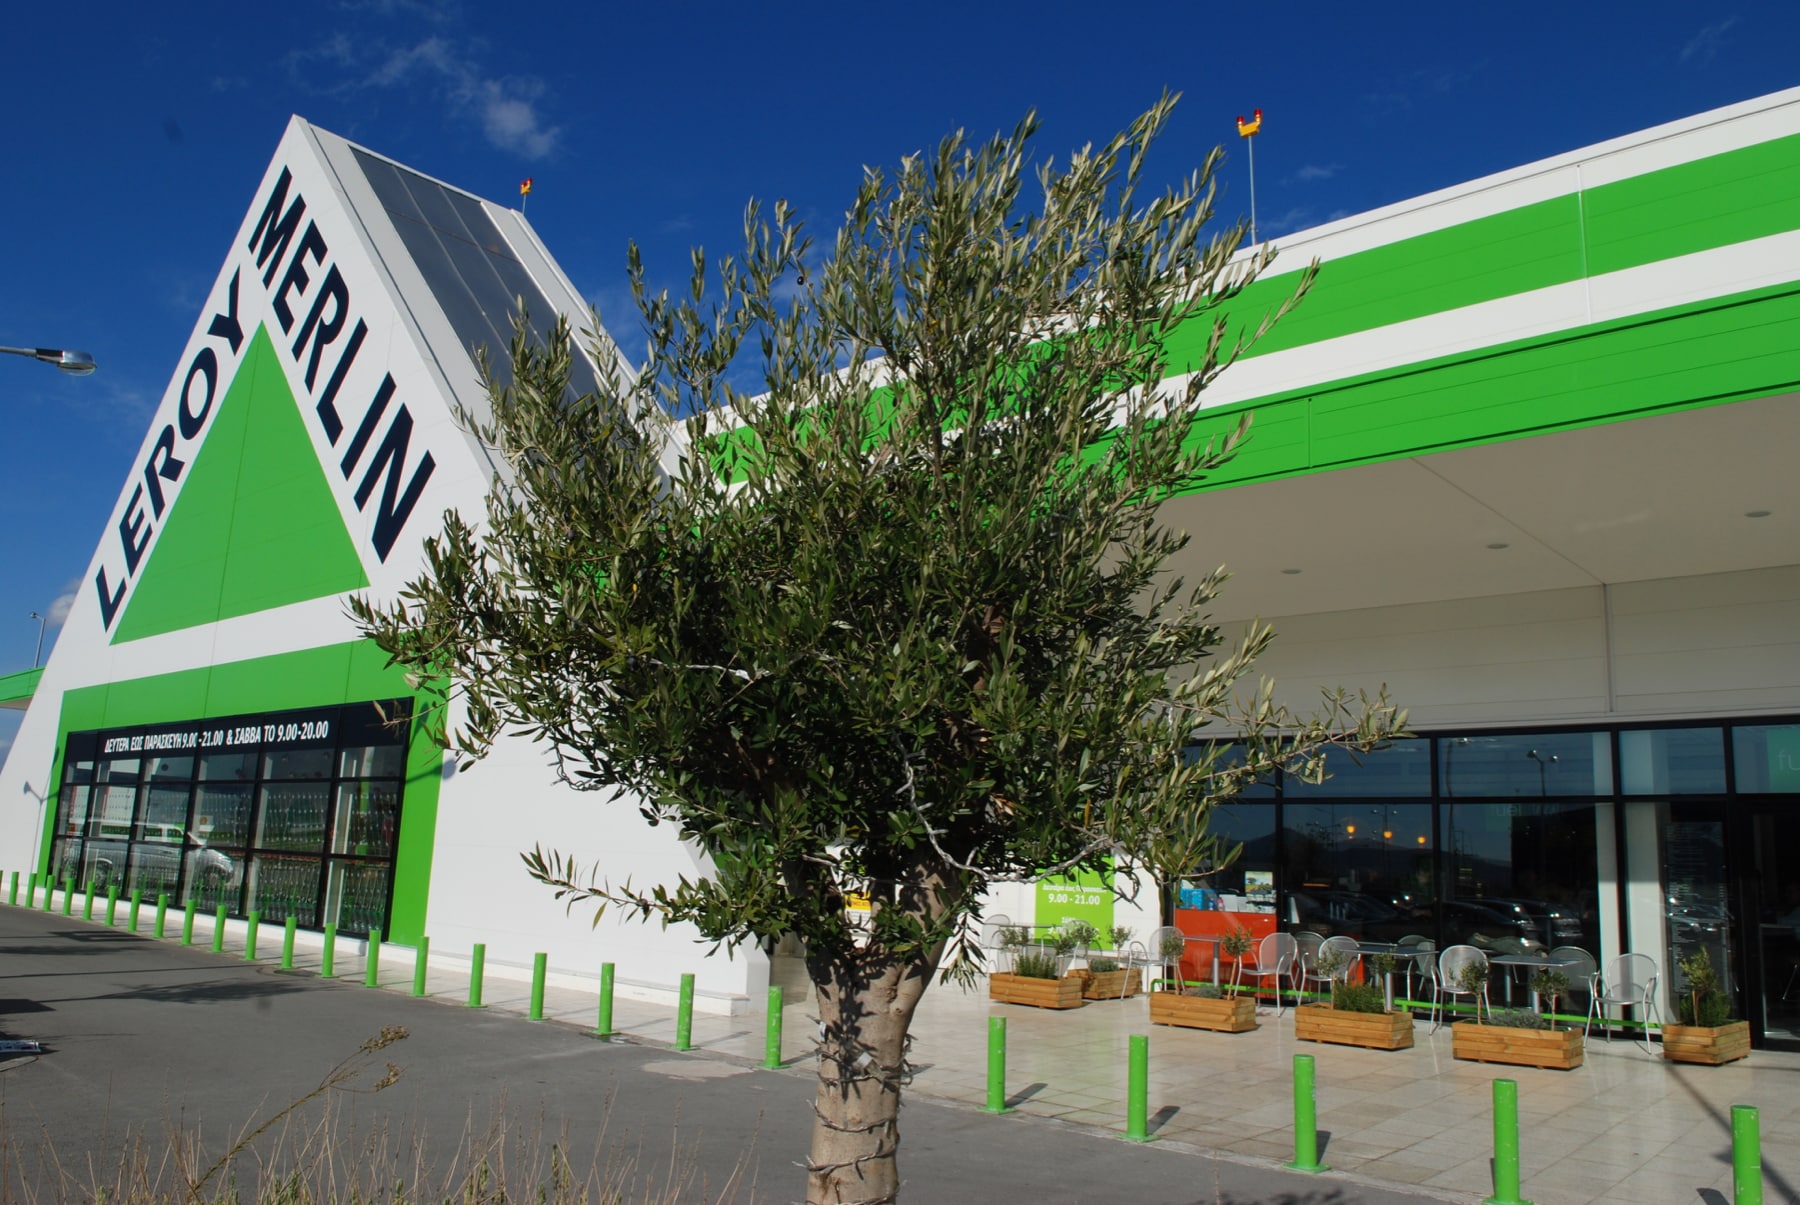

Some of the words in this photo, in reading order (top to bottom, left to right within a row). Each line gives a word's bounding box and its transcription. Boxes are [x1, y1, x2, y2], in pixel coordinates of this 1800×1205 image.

[95, 263, 244, 633] LEROY
[247, 164, 437, 565] MERLIN
[1048, 893, 1068, 903] 9.00
[1075, 894, 1101, 905] 21.00
